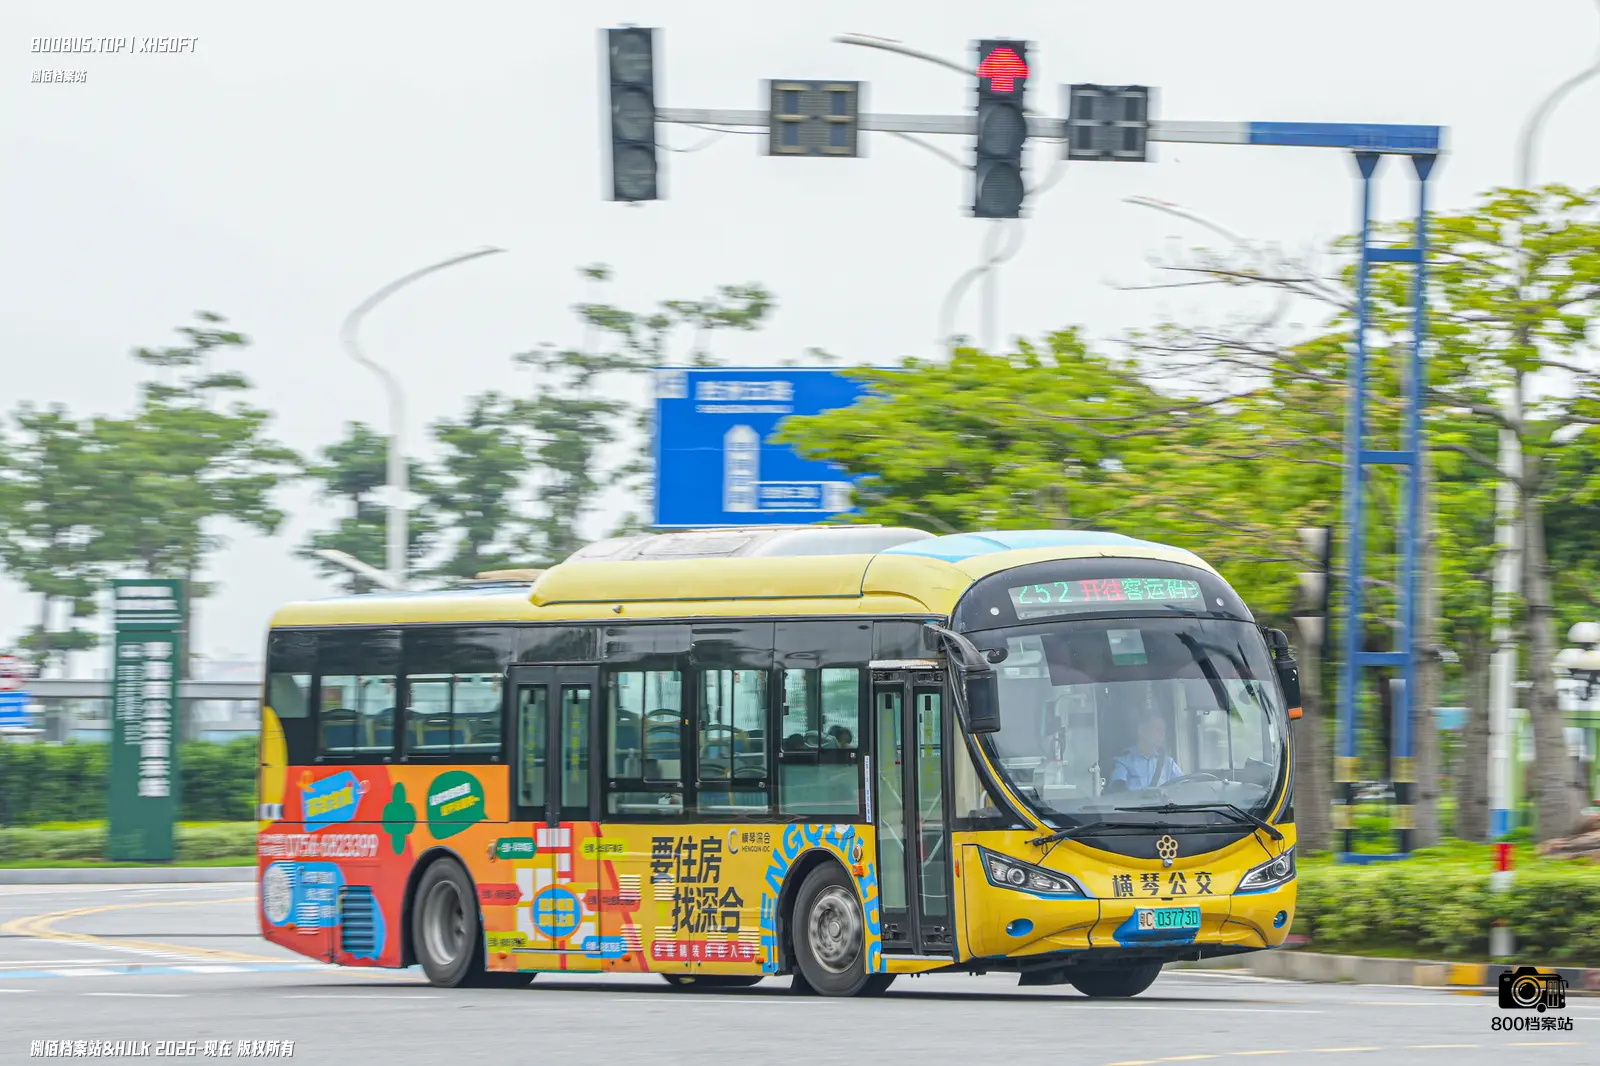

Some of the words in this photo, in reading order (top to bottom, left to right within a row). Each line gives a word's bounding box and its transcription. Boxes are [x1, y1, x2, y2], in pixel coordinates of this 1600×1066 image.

[742, 832, 770, 844] 横琴深合
[650, 836, 722, 884] 要住房
[1112, 871, 1213, 897] 横琴公交
[672, 886, 744, 933] 找深合
